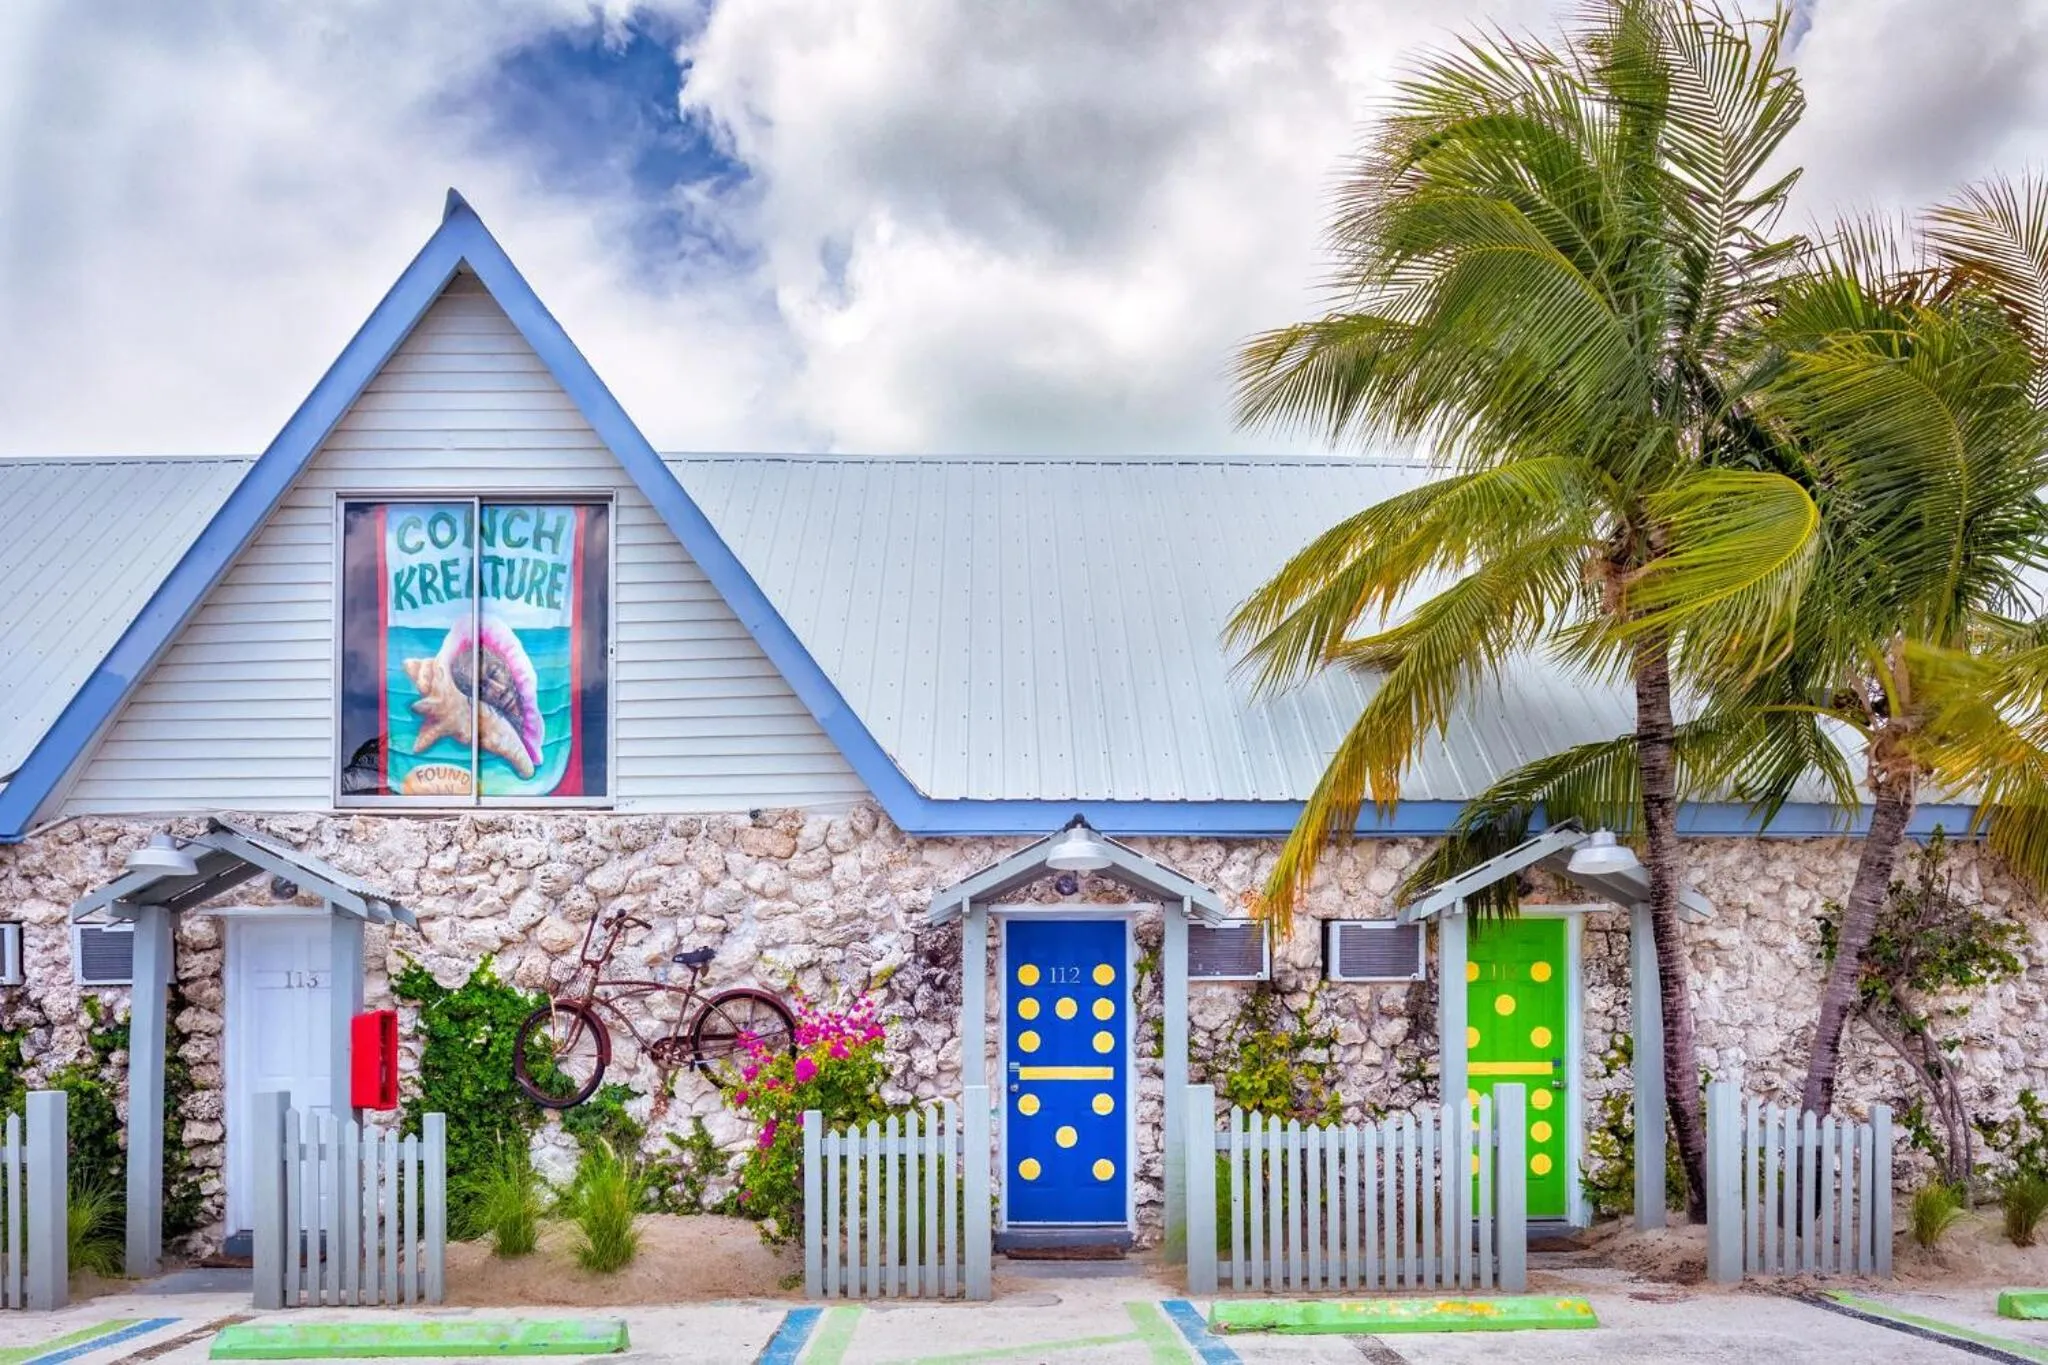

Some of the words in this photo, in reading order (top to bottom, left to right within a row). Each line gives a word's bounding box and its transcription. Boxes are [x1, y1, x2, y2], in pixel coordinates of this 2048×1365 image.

[396, 506, 567, 555] CONCH
[394, 555, 567, 611] KREATURE
[415, 766, 470, 786] FOUND
[285, 969, 319, 989] 113
[1049, 967, 1081, 984] 112
